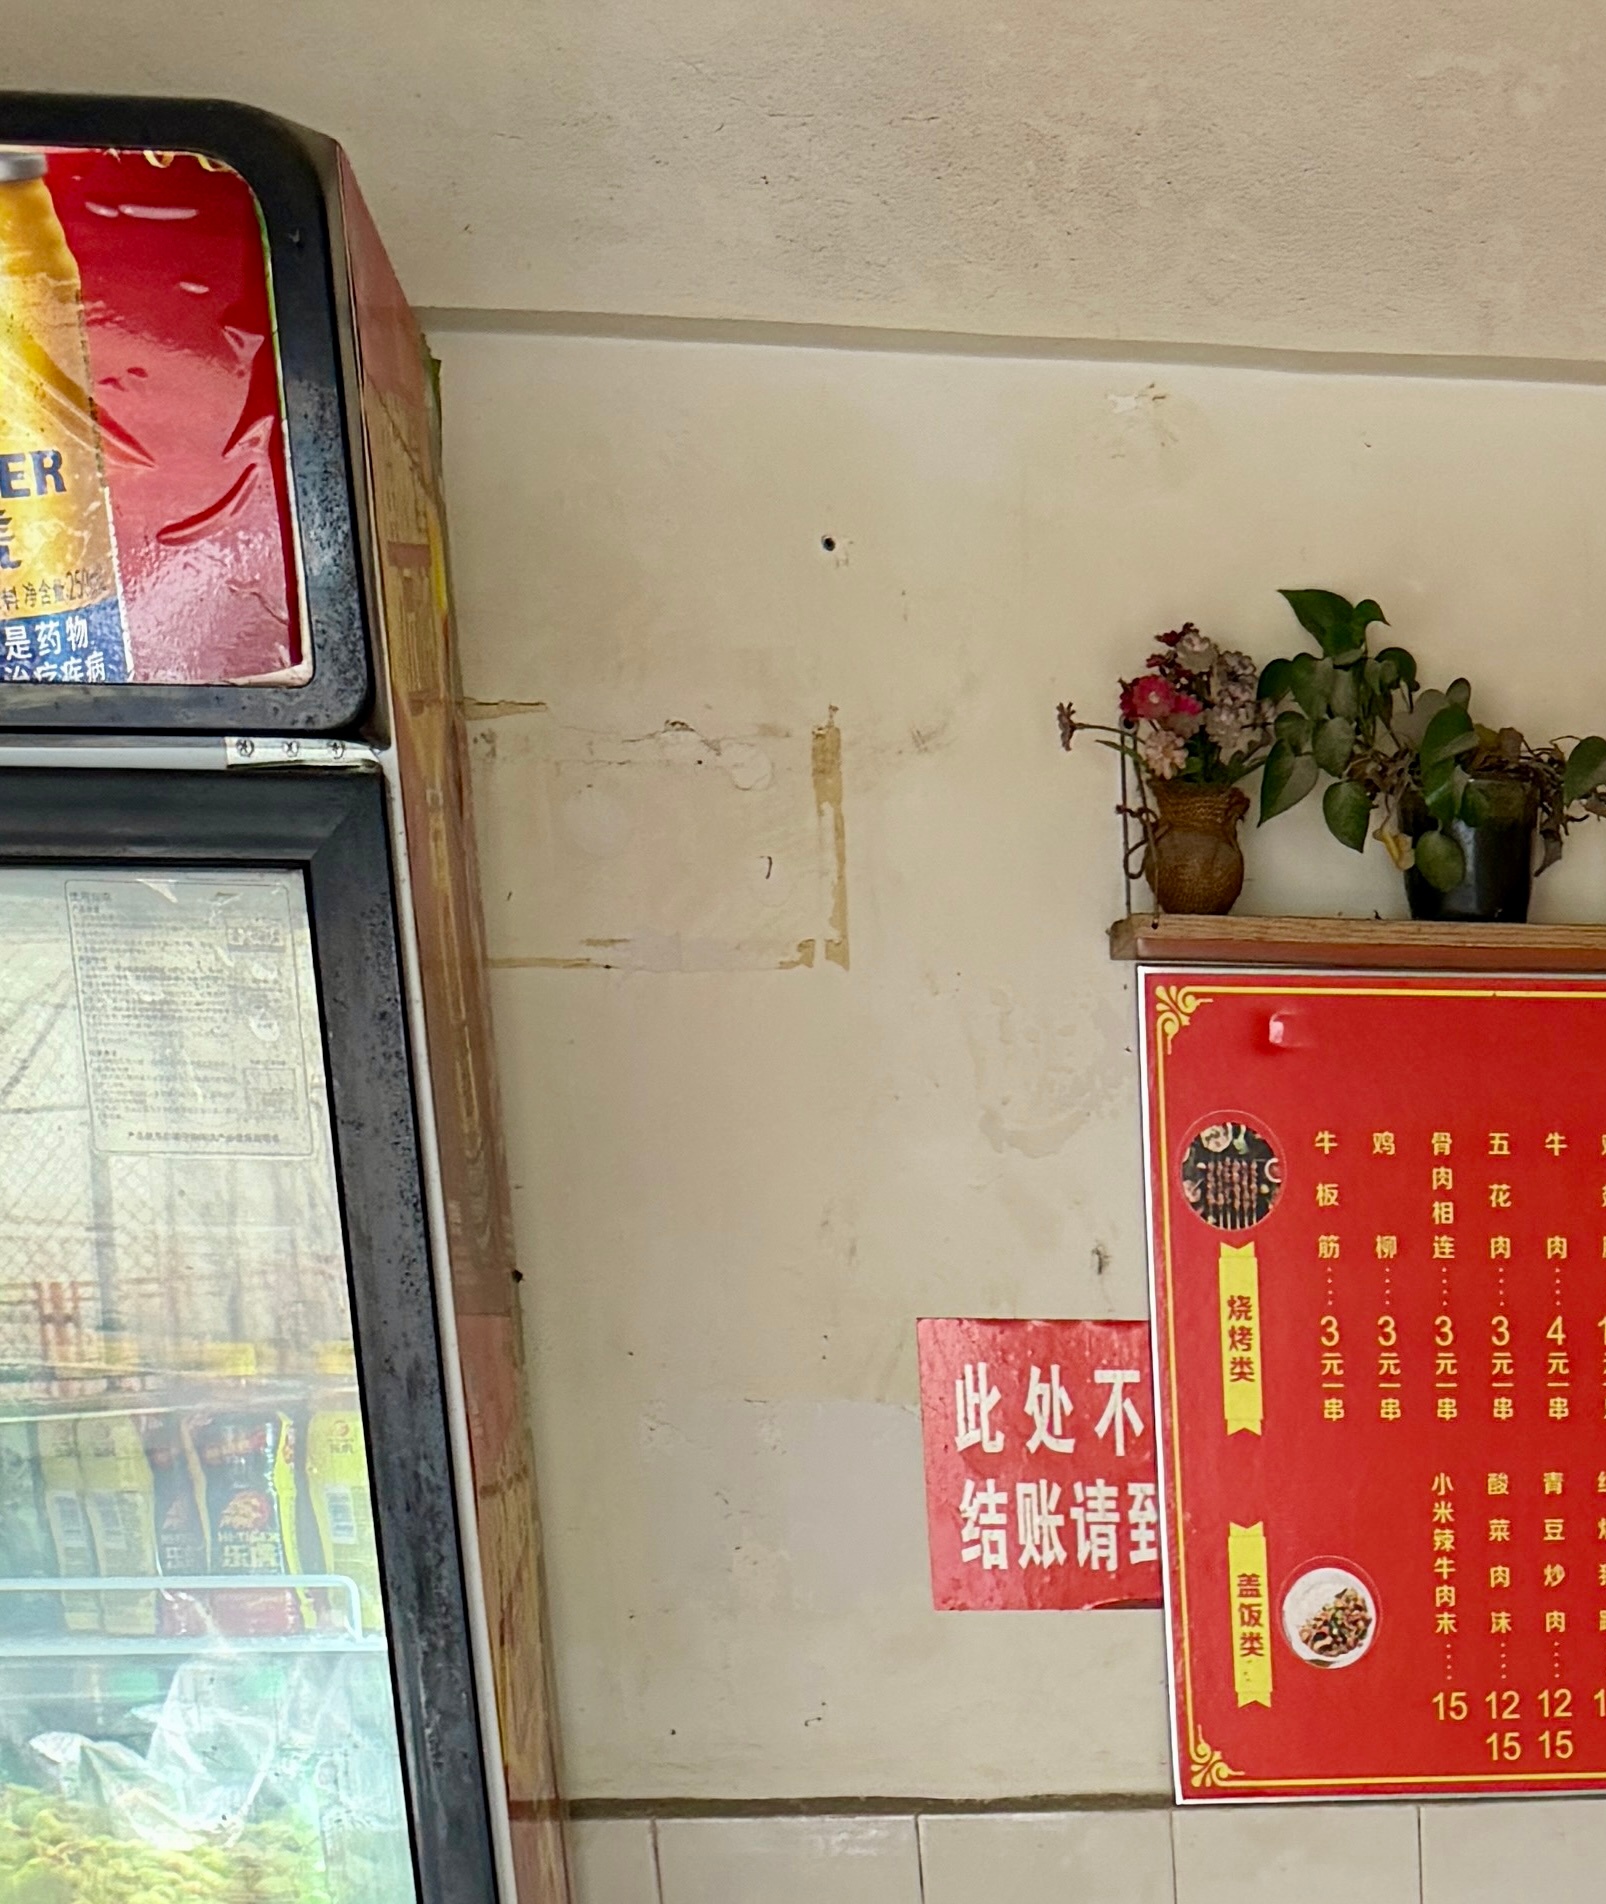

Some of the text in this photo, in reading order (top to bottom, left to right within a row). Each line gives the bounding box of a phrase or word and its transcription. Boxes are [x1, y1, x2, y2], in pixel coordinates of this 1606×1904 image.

[1314, 1130, 1340, 1259] 牛板筋
[1372, 1130, 1398, 1260] 鸡柳
[1430, 1131, 1455, 1259] 骨肉相连
[1488, 1132, 1512, 1260] 五花肉
[1544, 1131, 1568, 1260] 牛肉
[1226, 1295, 1256, 1383] 烧烤类
[955, 1362, 1145, 1457] 此处不
[1236, 1572, 1264, 1659] 盖饭类
[1431, 1472, 1468, 1721] 小米辣牛肉末 15
[1485, 1472, 1522, 1761] 酸菜肉沫 12 15
[1537, 1471, 1574, 1759] 青豆炒肉 12 15
